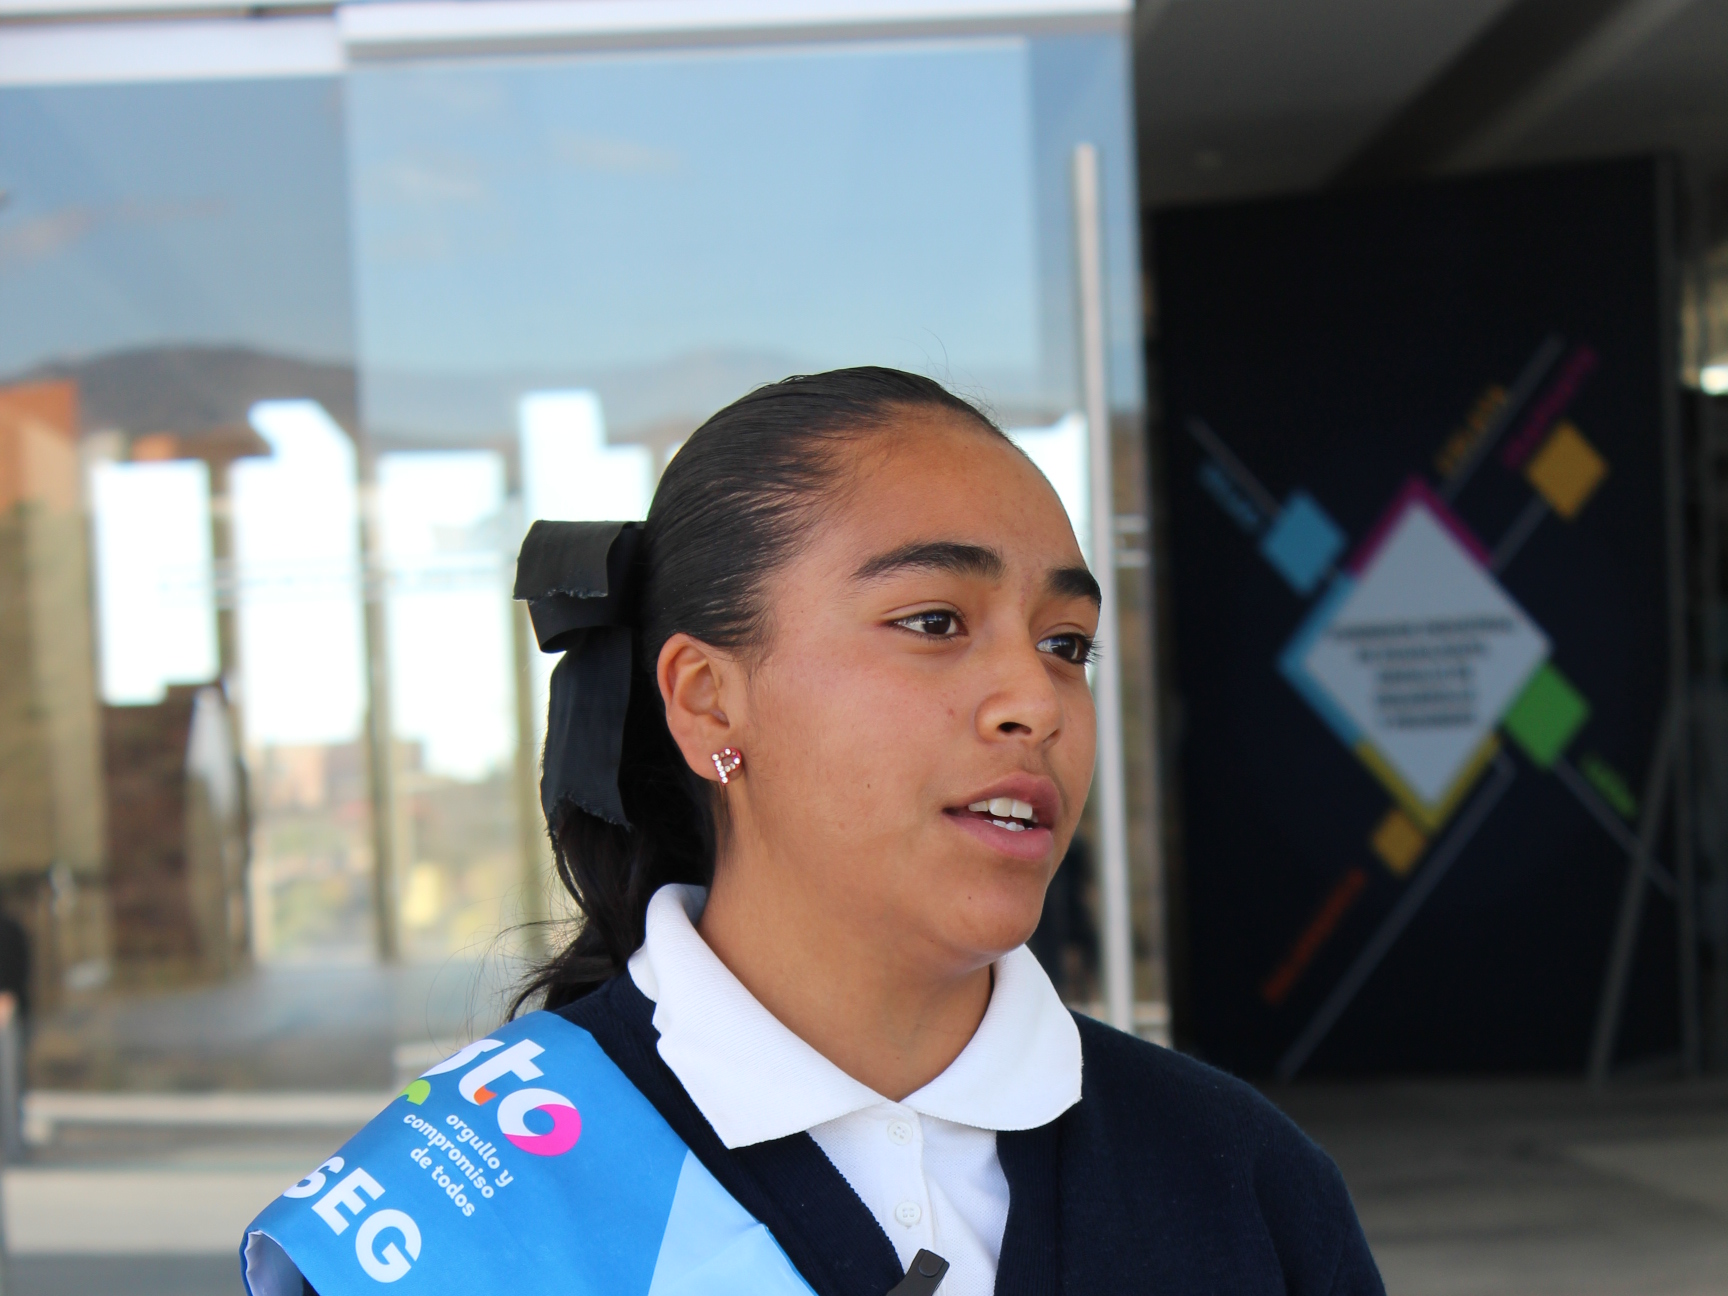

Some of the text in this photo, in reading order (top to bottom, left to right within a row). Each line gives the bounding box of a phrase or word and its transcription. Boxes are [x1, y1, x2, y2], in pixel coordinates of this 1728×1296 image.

[403, 1113, 494, 1198] compromiso
[410, 1147, 475, 1216] de todos
[446, 1114, 514, 1187] orgullo y
